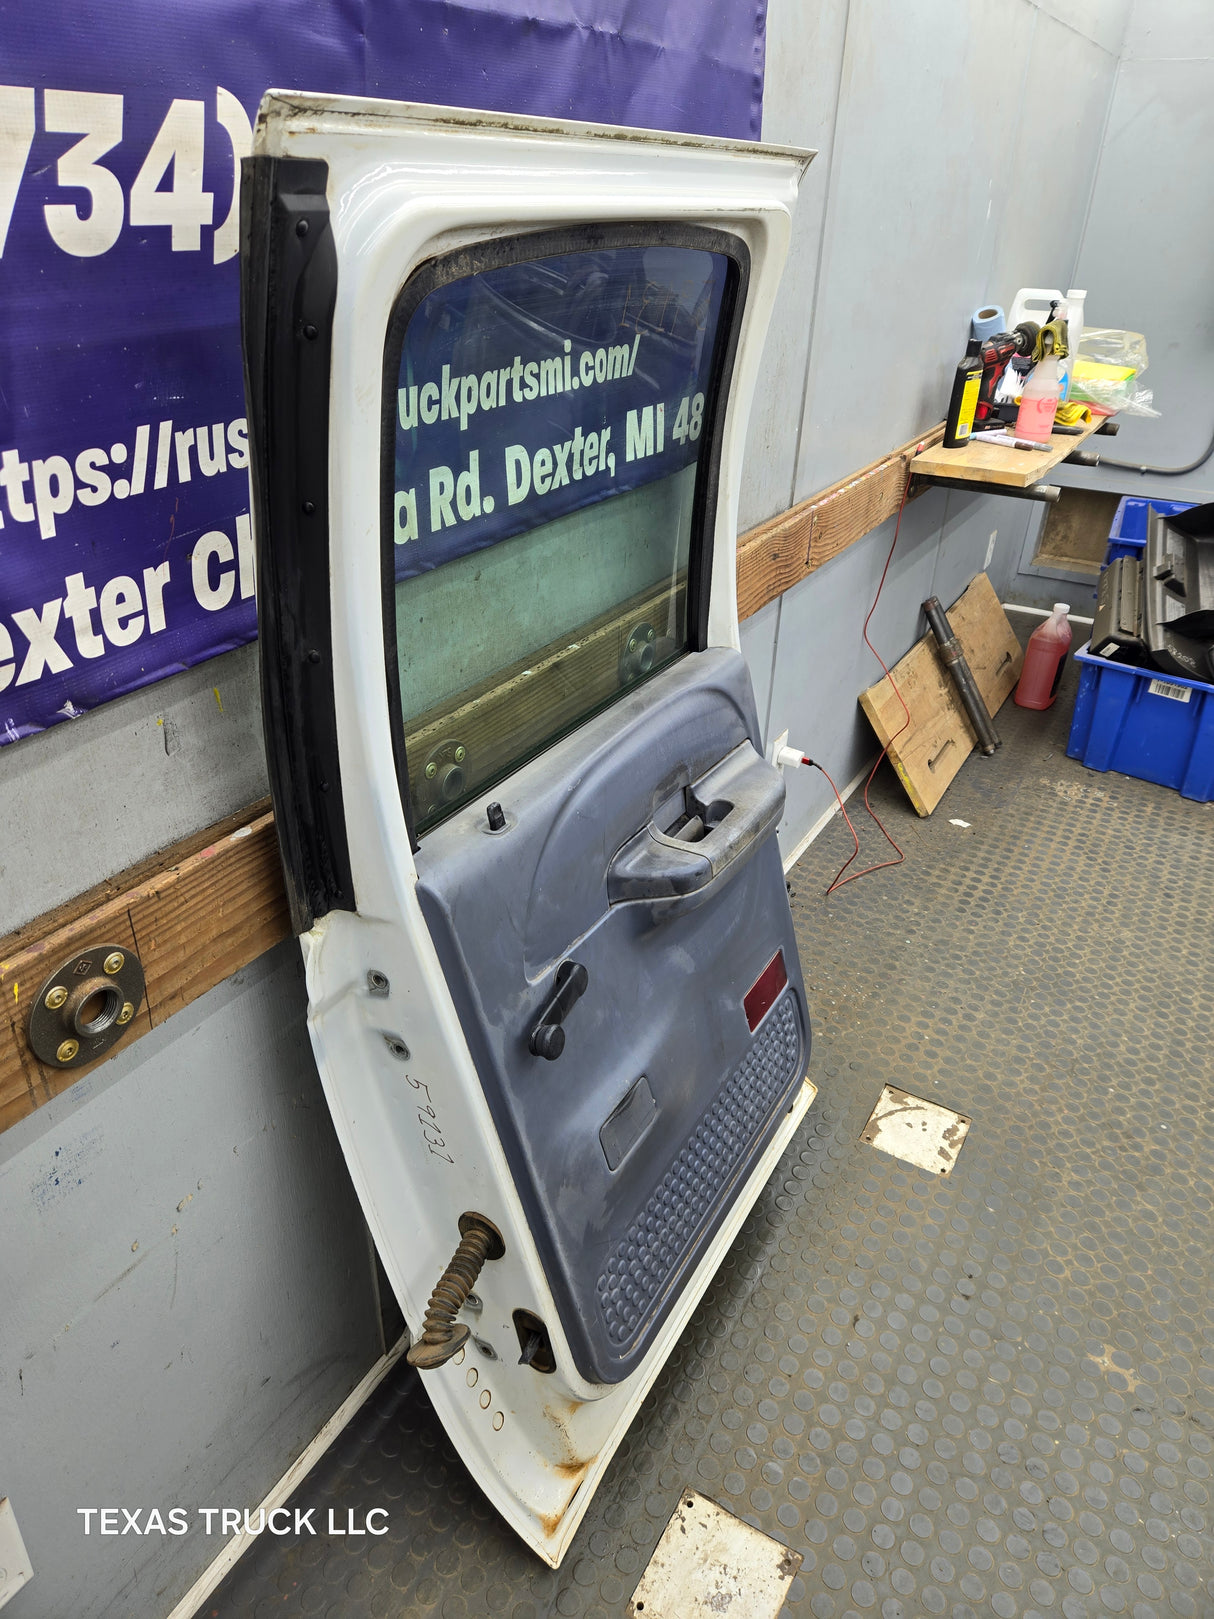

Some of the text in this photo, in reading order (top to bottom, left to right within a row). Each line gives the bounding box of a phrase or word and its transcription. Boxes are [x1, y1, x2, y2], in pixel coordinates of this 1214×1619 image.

[0, 334, 641, 540] tps://rus uckpartsmi.com/
[429, 449, 495, 533] Rd.
[505, 426, 616, 506] Dexter,
[626, 402, 665, 462] MI
[672, 391, 705, 446] 48
[405, 1074, 455, 1164] 59131
